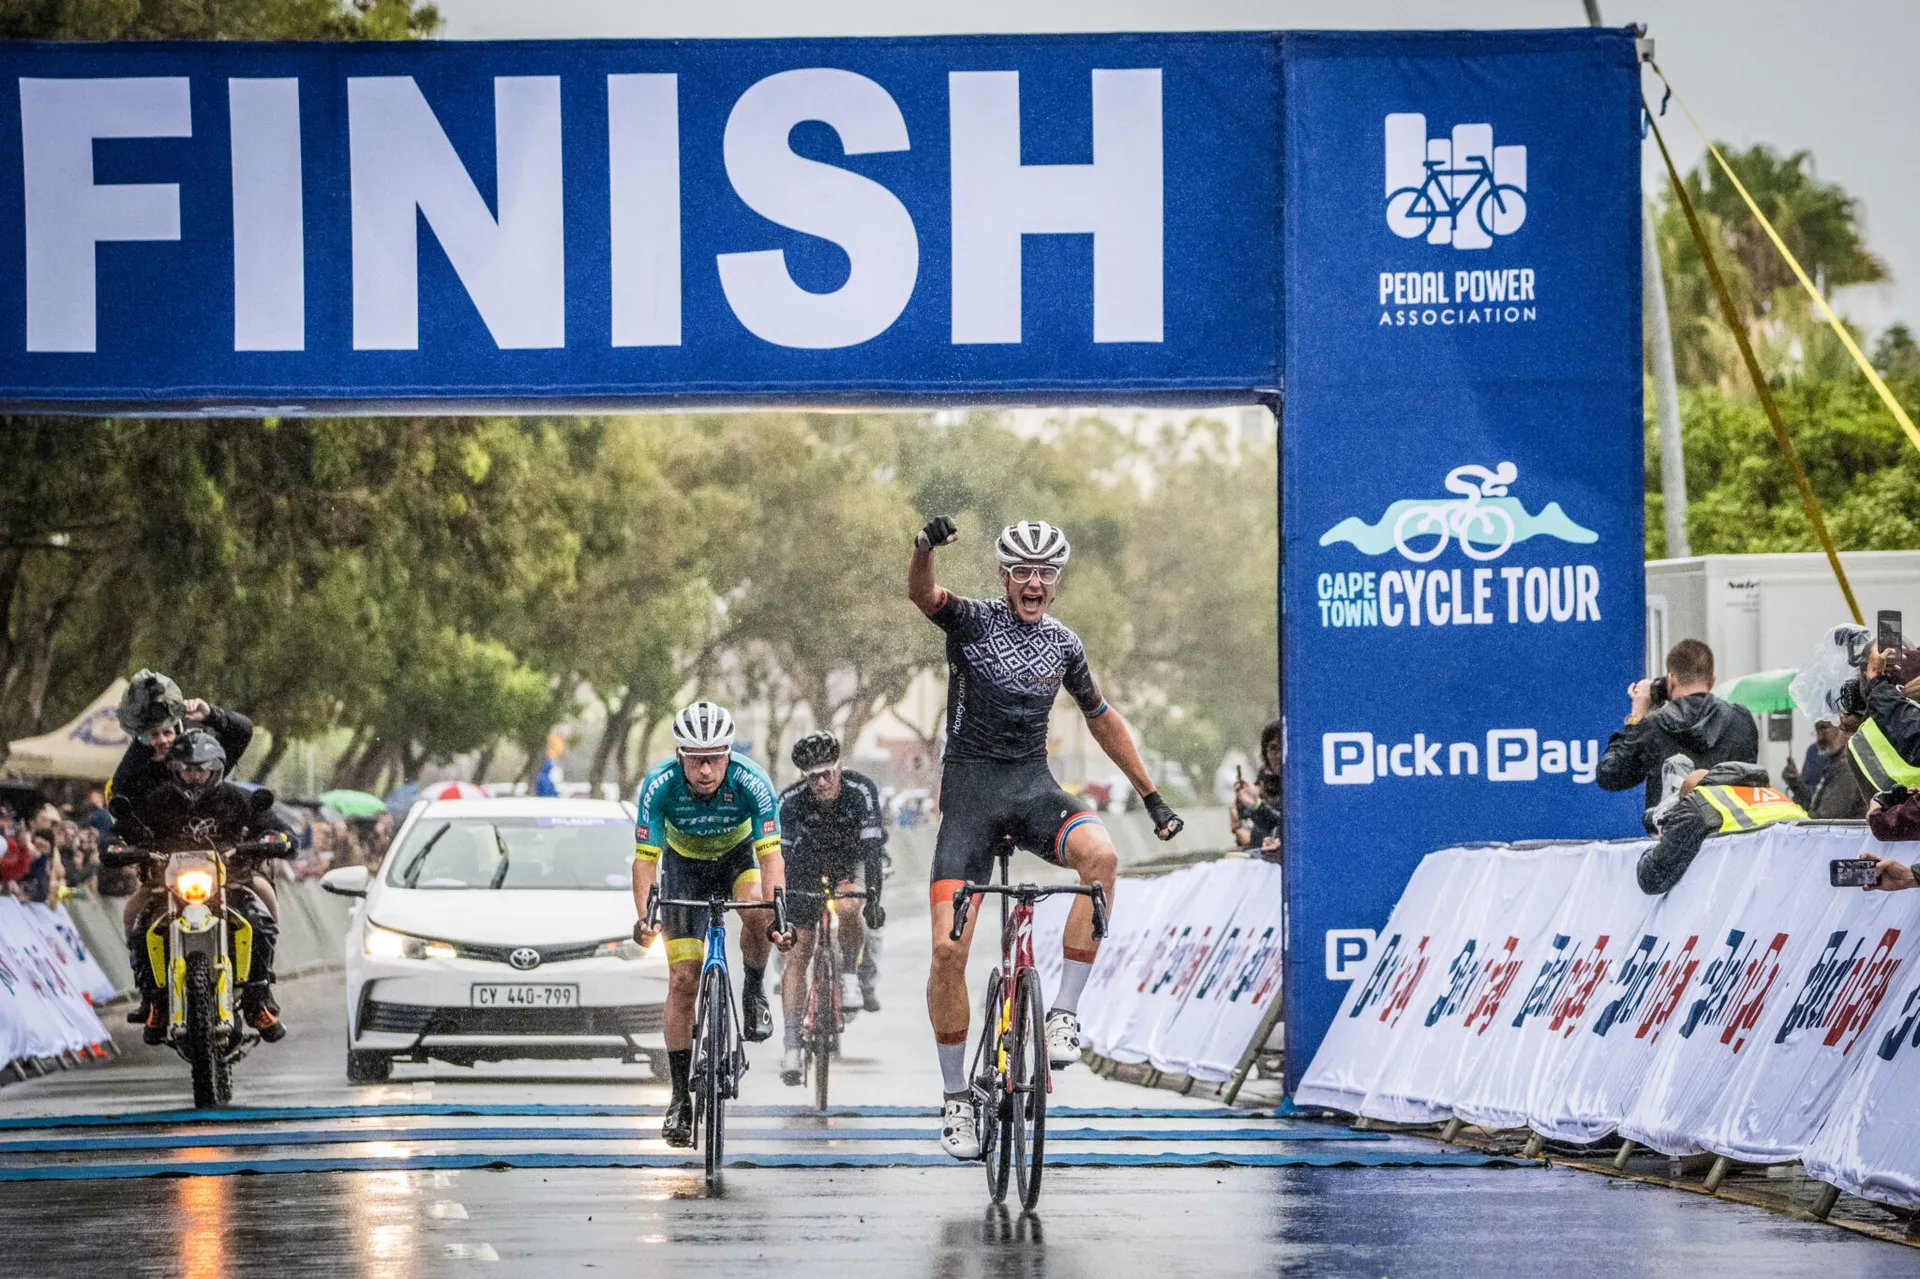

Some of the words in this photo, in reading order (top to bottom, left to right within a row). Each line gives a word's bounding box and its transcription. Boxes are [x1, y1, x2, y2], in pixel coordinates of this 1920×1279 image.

[19, 67, 1164, 352] FINISH
[1379, 272, 1450, 305] PEDAL
[1455, 268, 1535, 303] POWER
[1378, 306, 1537, 327] ASSOCIATION
[1318, 571, 1376, 600] CAPE
[1378, 568, 1494, 628] CYCLE
[1501, 564, 1601, 624] TOUR
[1319, 600, 1378, 628] TOWN
[642, 769, 674, 824] SRAM
[732, 766, 773, 816] ROCKSHOX
[480, 988, 497, 1004] CY
[508, 988, 571, 1004] 440-799
